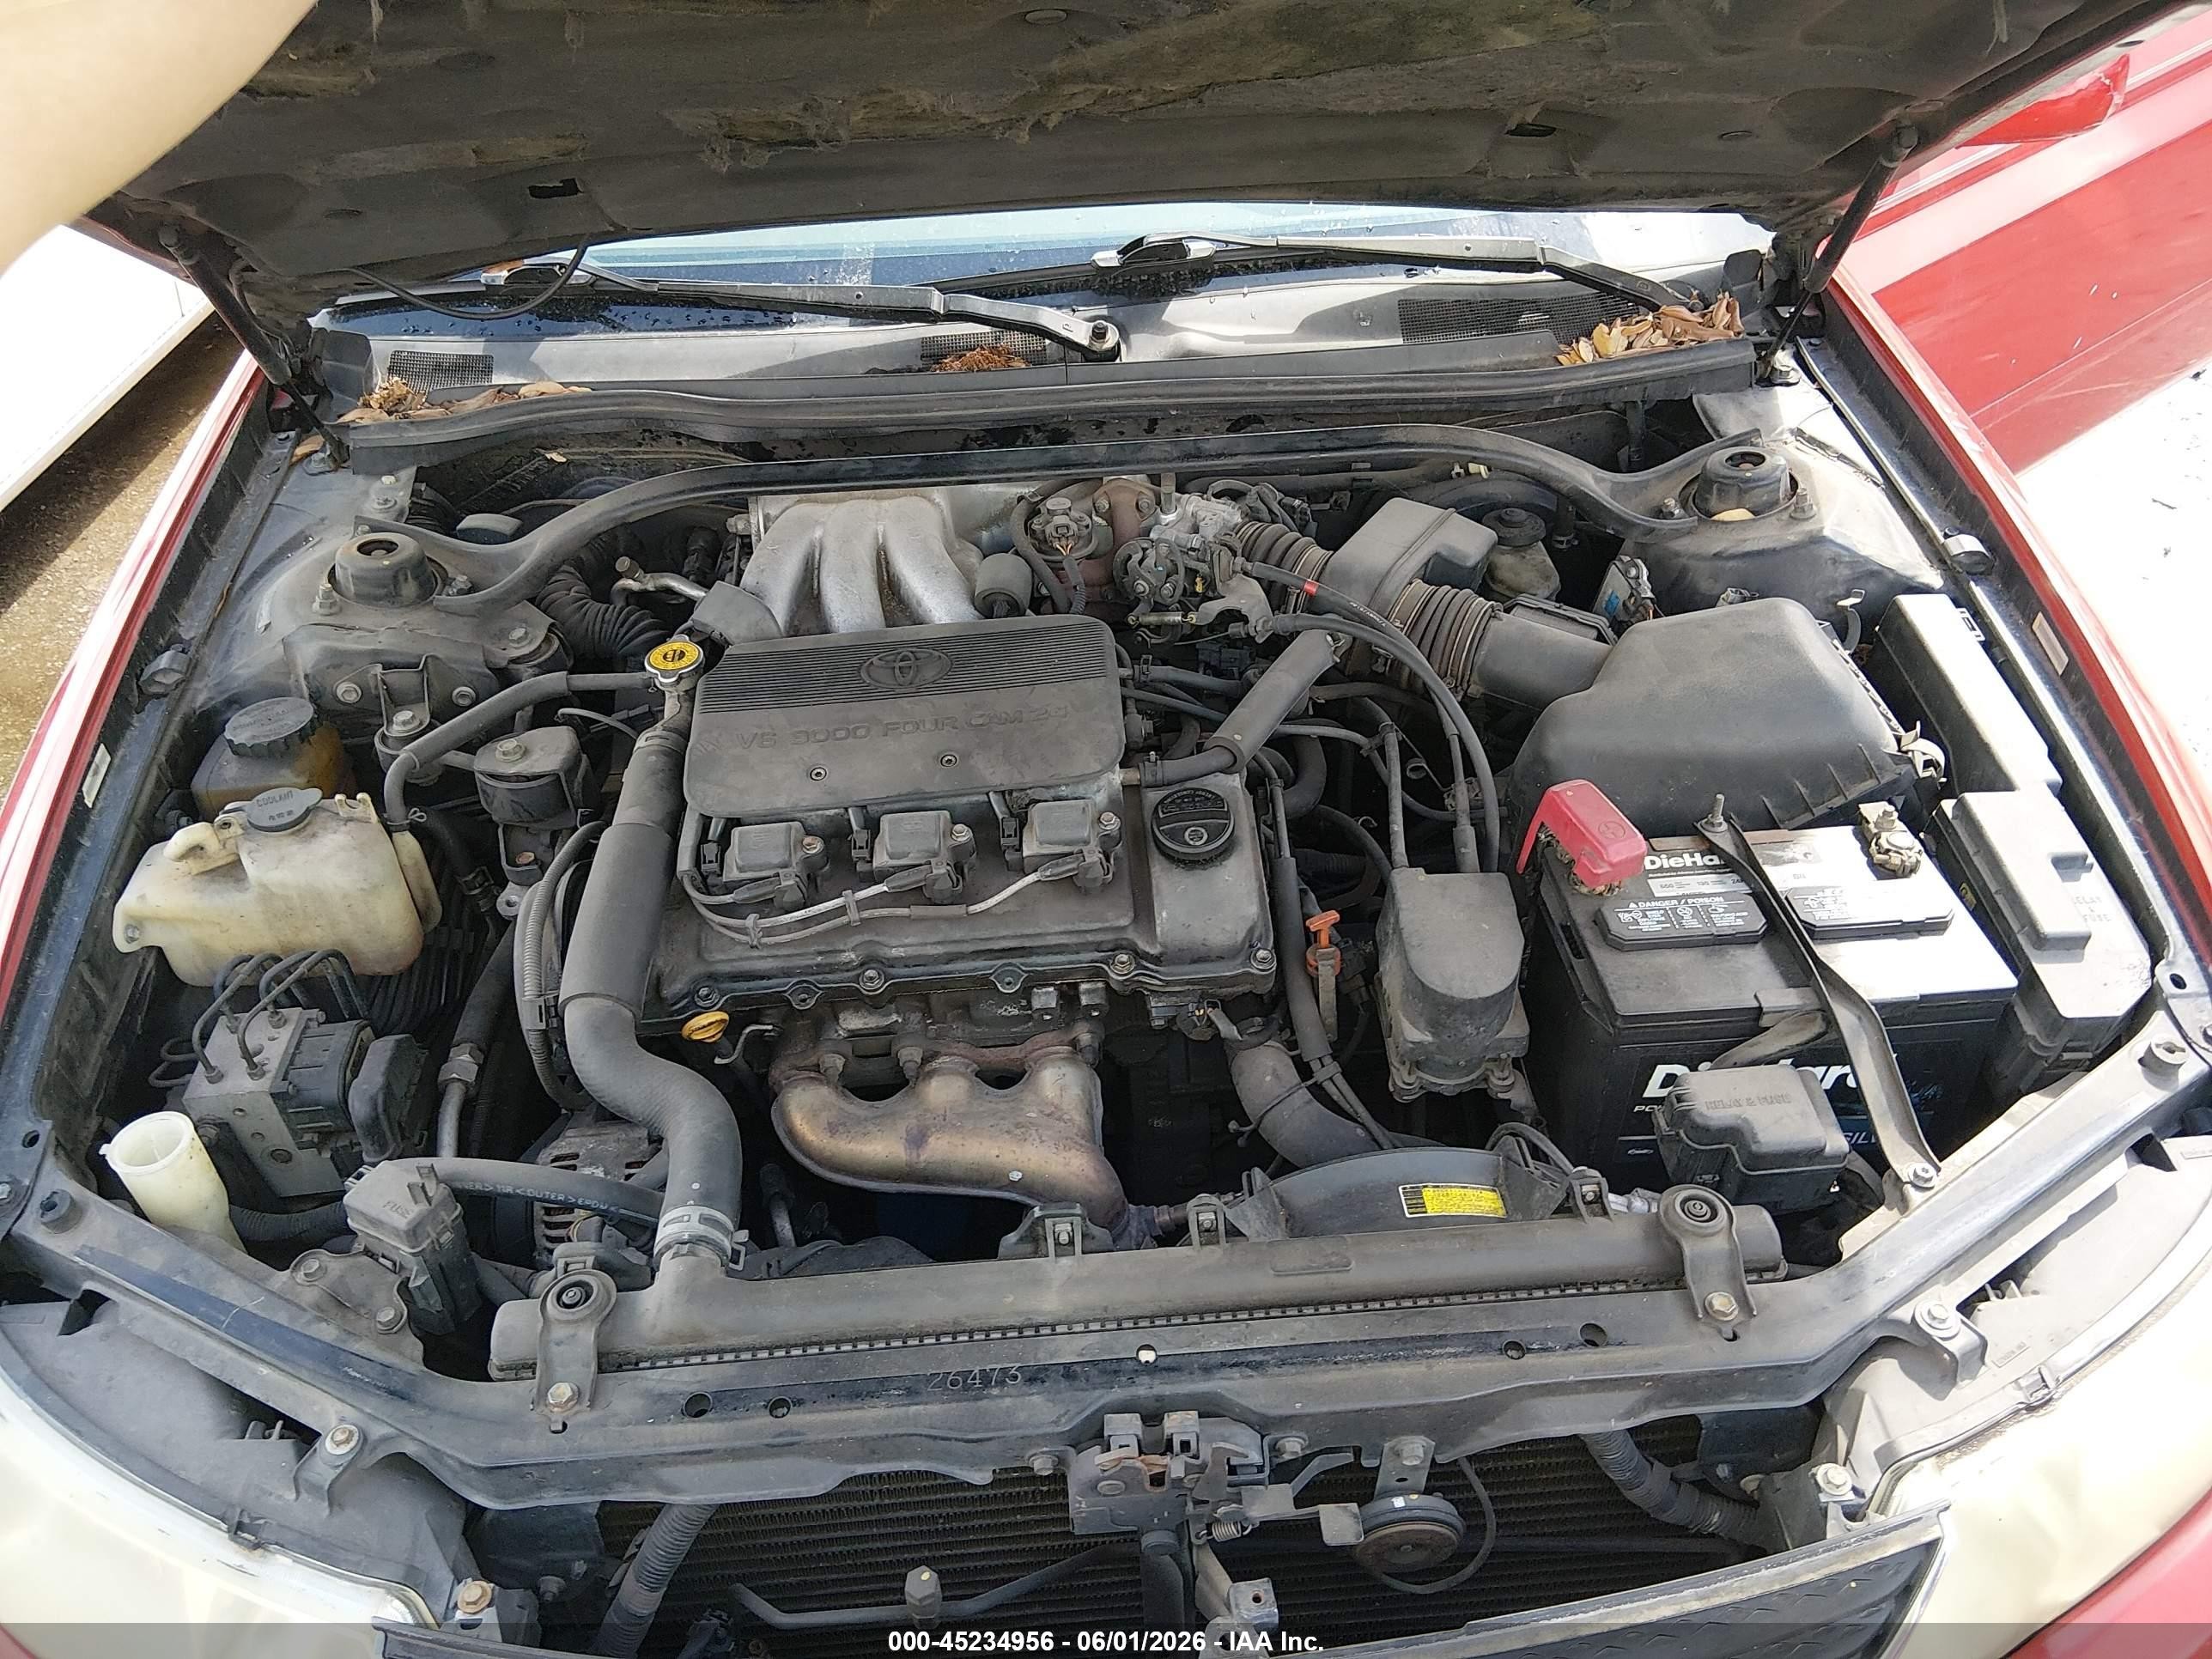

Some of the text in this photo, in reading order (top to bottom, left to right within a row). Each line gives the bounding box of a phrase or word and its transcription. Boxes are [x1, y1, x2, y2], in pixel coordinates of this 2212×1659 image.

[882, 714, 958, 738] FOUR
[968, 709, 1024, 729] CAM
[1644, 853, 1726, 870] DieHa
[1638, 899, 1679, 908] DANGER
[1687, 896, 1725, 905] POISON
[927, 1363, 1022, 1391] 26473
